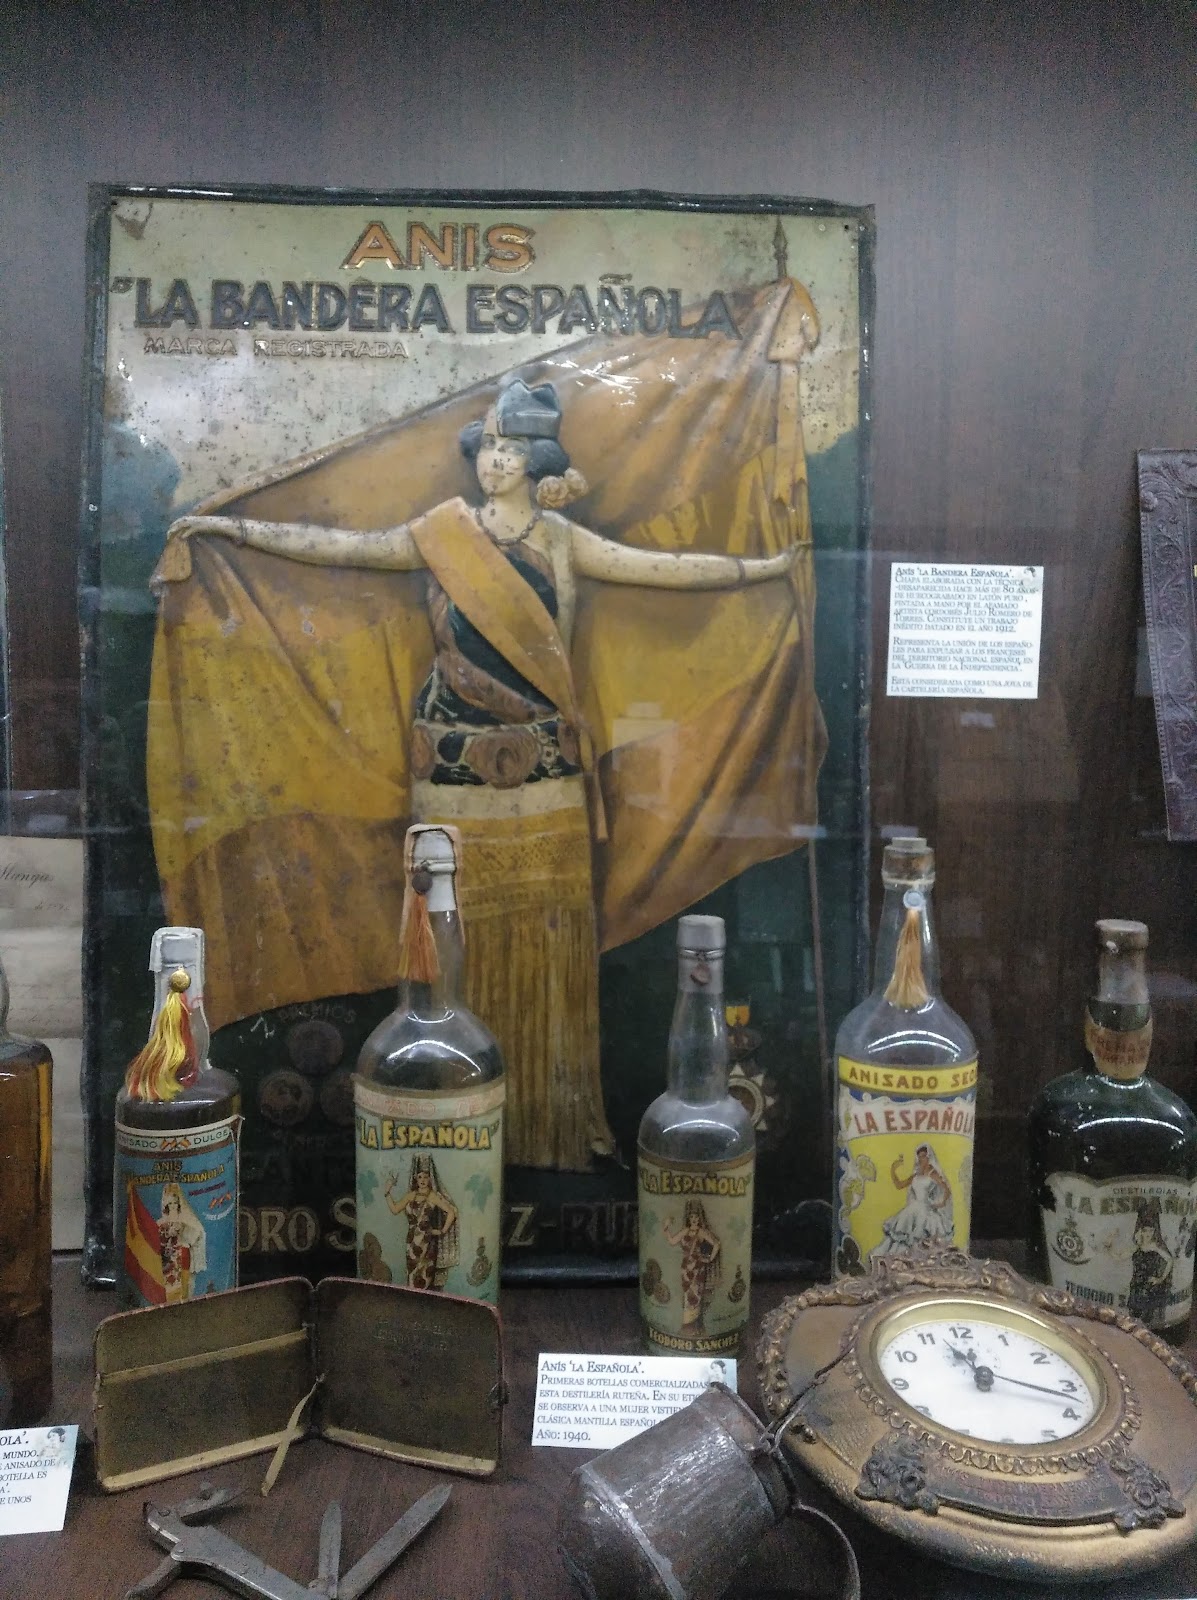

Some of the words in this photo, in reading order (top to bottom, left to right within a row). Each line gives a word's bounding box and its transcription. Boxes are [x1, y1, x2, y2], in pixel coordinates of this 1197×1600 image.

[338, 219, 536, 273] ANIS
[211, 278, 455, 333] BANDERA
[466, 273, 743, 341] ESPAÑOLA
[144, 337, 238, 357] MARCA
[253, 339, 409, 360] REGISTRADA
[849, 1065, 939, 1092] ANISADO
[853, 1110, 879, 1134] LA
[193, 1129, 230, 1145] DULCE
[381, 1118, 492, 1150] ESPAÑOLA
[659, 1169, 748, 1197] ESPAÑOLA
[917, 1332, 936, 1346] 11
[948, 1326, 974, 1340] 12
[998, 1334, 1009, 1347] 1
[894, 1350, 918, 1364] 10
[1030, 1351, 1050, 1365] 2
[540, 1374, 585, 1386] PRIMERAS
[586, 1378, 628, 1387] BOTELLAS
[629, 1378, 708, 1389] COMERCIALIZADAS
[891, 1378, 909, 1391] 9
[1059, 1379, 1078, 1393] 3
[539, 1389, 560, 1399] ESTA
[561, 1388, 610, 1400] DESTILERÍA
[652, 1390, 666, 1401] EN
[668, 1393, 680, 1402] SU
[538, 1402, 549, 1411] SE
[550, 1402, 589, 1412] OBSERVA
[590, 1403, 597, 1412] A
[599, 1403, 618, 1413] UNA
[619, 1404, 650, 1414] MUJER
[1062, 1407, 1081, 1421] 4
[537, 1414, 572, 1425] CLÁSICA
[573, 1416, 617, 1426] MANTILLA
[4, 1460, 43, 1470] ANISADO
[44, 1458, 56, 1467] DE
[37, 1470, 48, 1479] ES
[7, 1494, 32, 1505] UNOS
